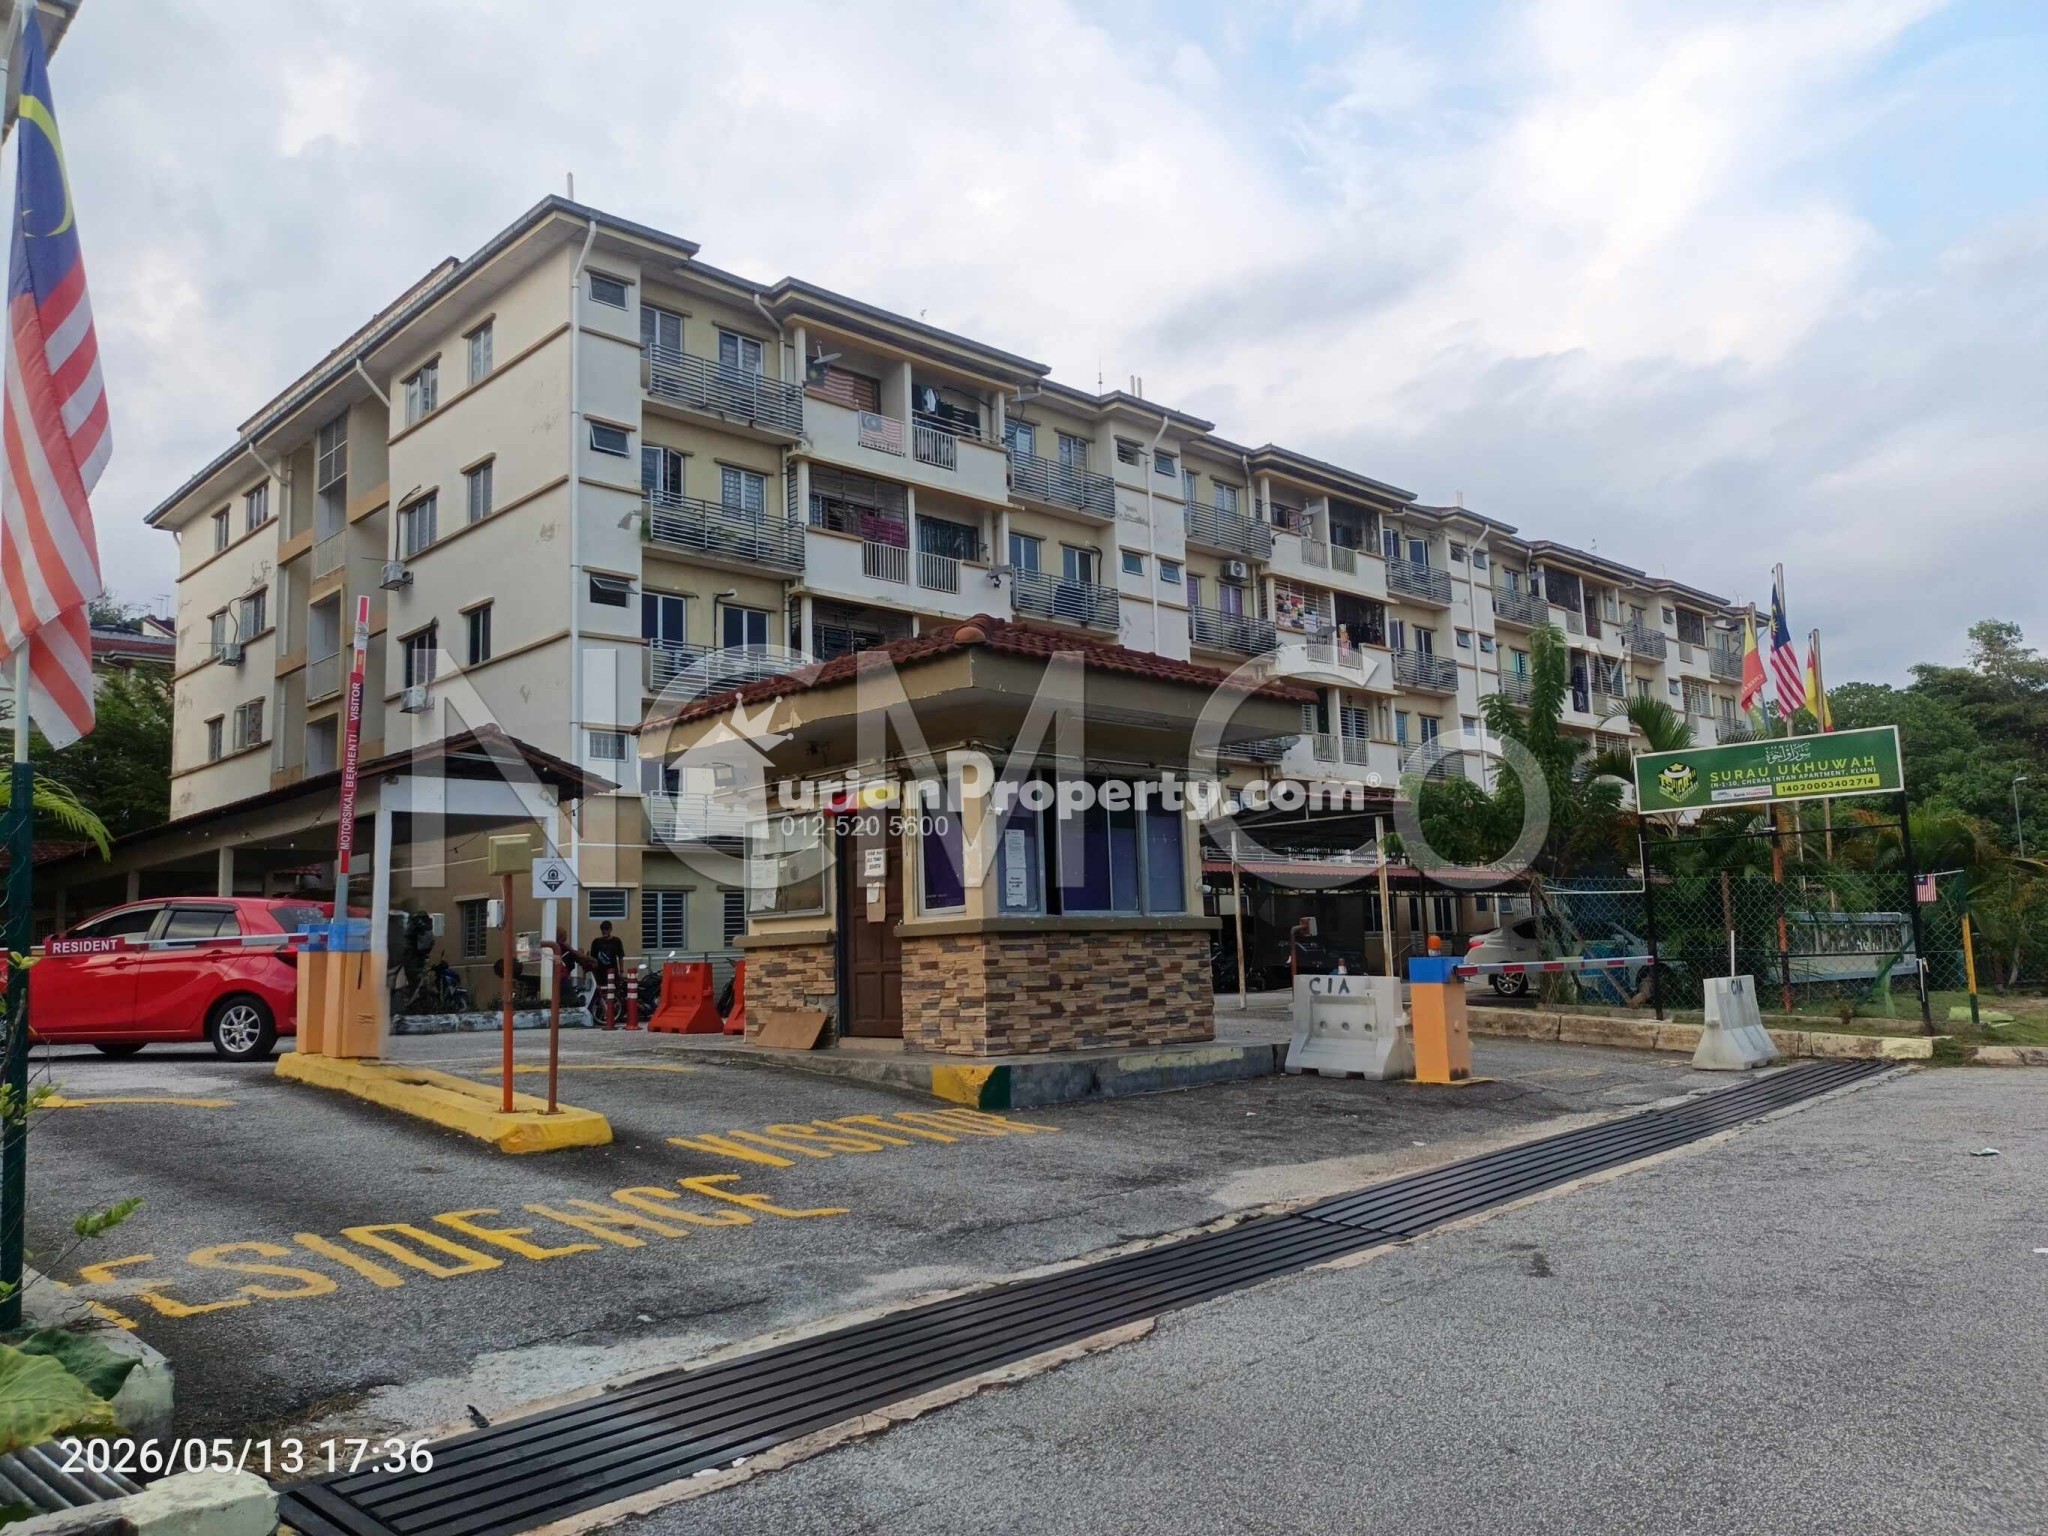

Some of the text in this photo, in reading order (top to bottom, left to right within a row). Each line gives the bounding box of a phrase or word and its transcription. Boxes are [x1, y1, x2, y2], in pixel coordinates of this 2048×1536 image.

[350, 682, 362, 722] VISITOR
[1710, 755, 1876, 782] SURAU UKHUWAH
[1741, 776, 1771, 786] CHERAS
[1773, 774, 1797, 783] INTAN
[1799, 768, 1849, 779] APARTMENT,
[1850, 766, 1877, 775] KLMN)
[340, 733, 358, 850] MOTORSIKAL BERHENTI
[1781, 777, 1875, 793] 14020003402714
[52, 939, 118, 954] RESIDENT
[1309, 977, 1351, 995] CIA
[667, 1108, 1061, 1168] VISITOR
